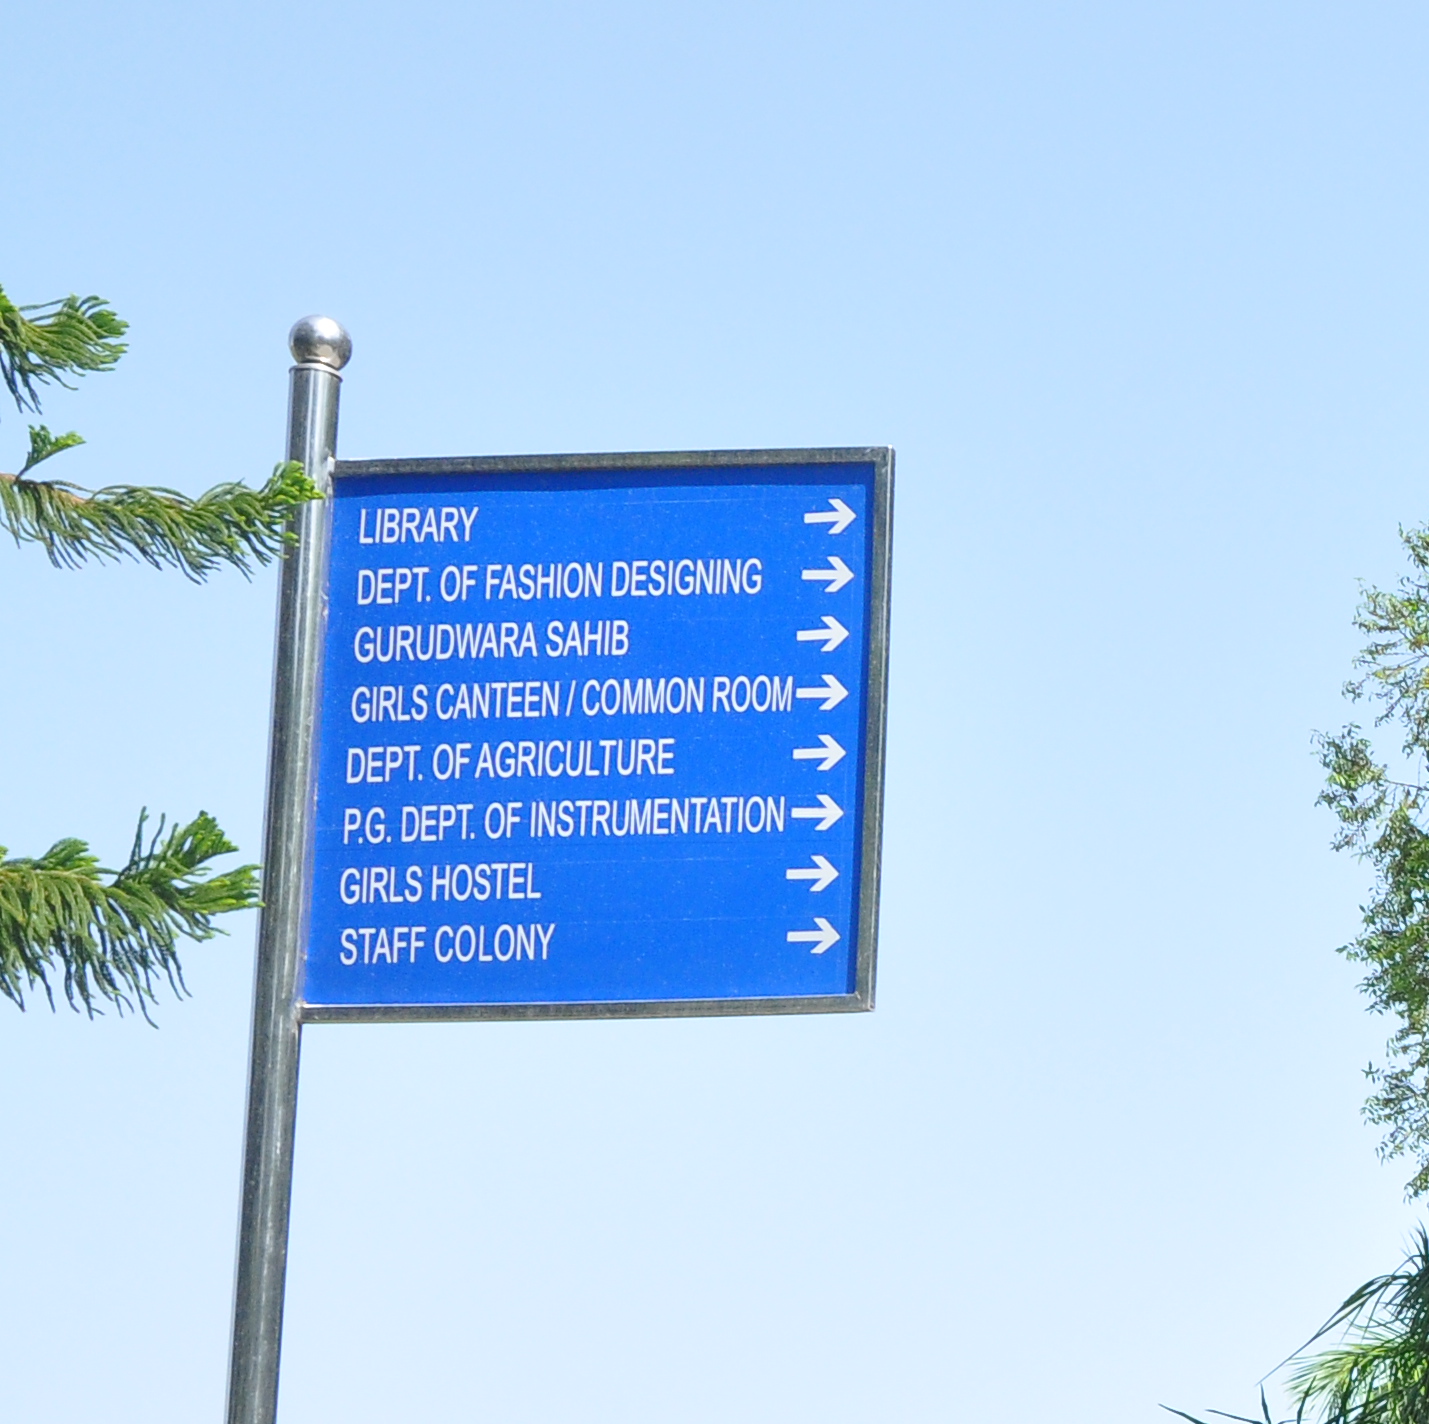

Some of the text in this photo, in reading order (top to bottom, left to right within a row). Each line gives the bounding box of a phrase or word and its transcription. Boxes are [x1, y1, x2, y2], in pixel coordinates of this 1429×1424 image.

[359, 506, 479, 544] LIBRARY
[357, 557, 762, 605] DEPT. OF FASHION DESIGNING
[354, 619, 629, 663] GURUDWARA SAHIB
[351, 684, 428, 723] GIRLS
[436, 680, 560, 720] CANTEEN
[582, 676, 705, 716] COMMON
[712, 675, 794, 713] ROOM
[346, 738, 675, 784] DEPT. OF AGRICULTURE
[343, 795, 785, 845] P.G. DEPT. OF INSTRUMENTATION
[340, 862, 542, 905] GIRLS HOSTEL
[340, 923, 556, 966] STAFF COLONY
